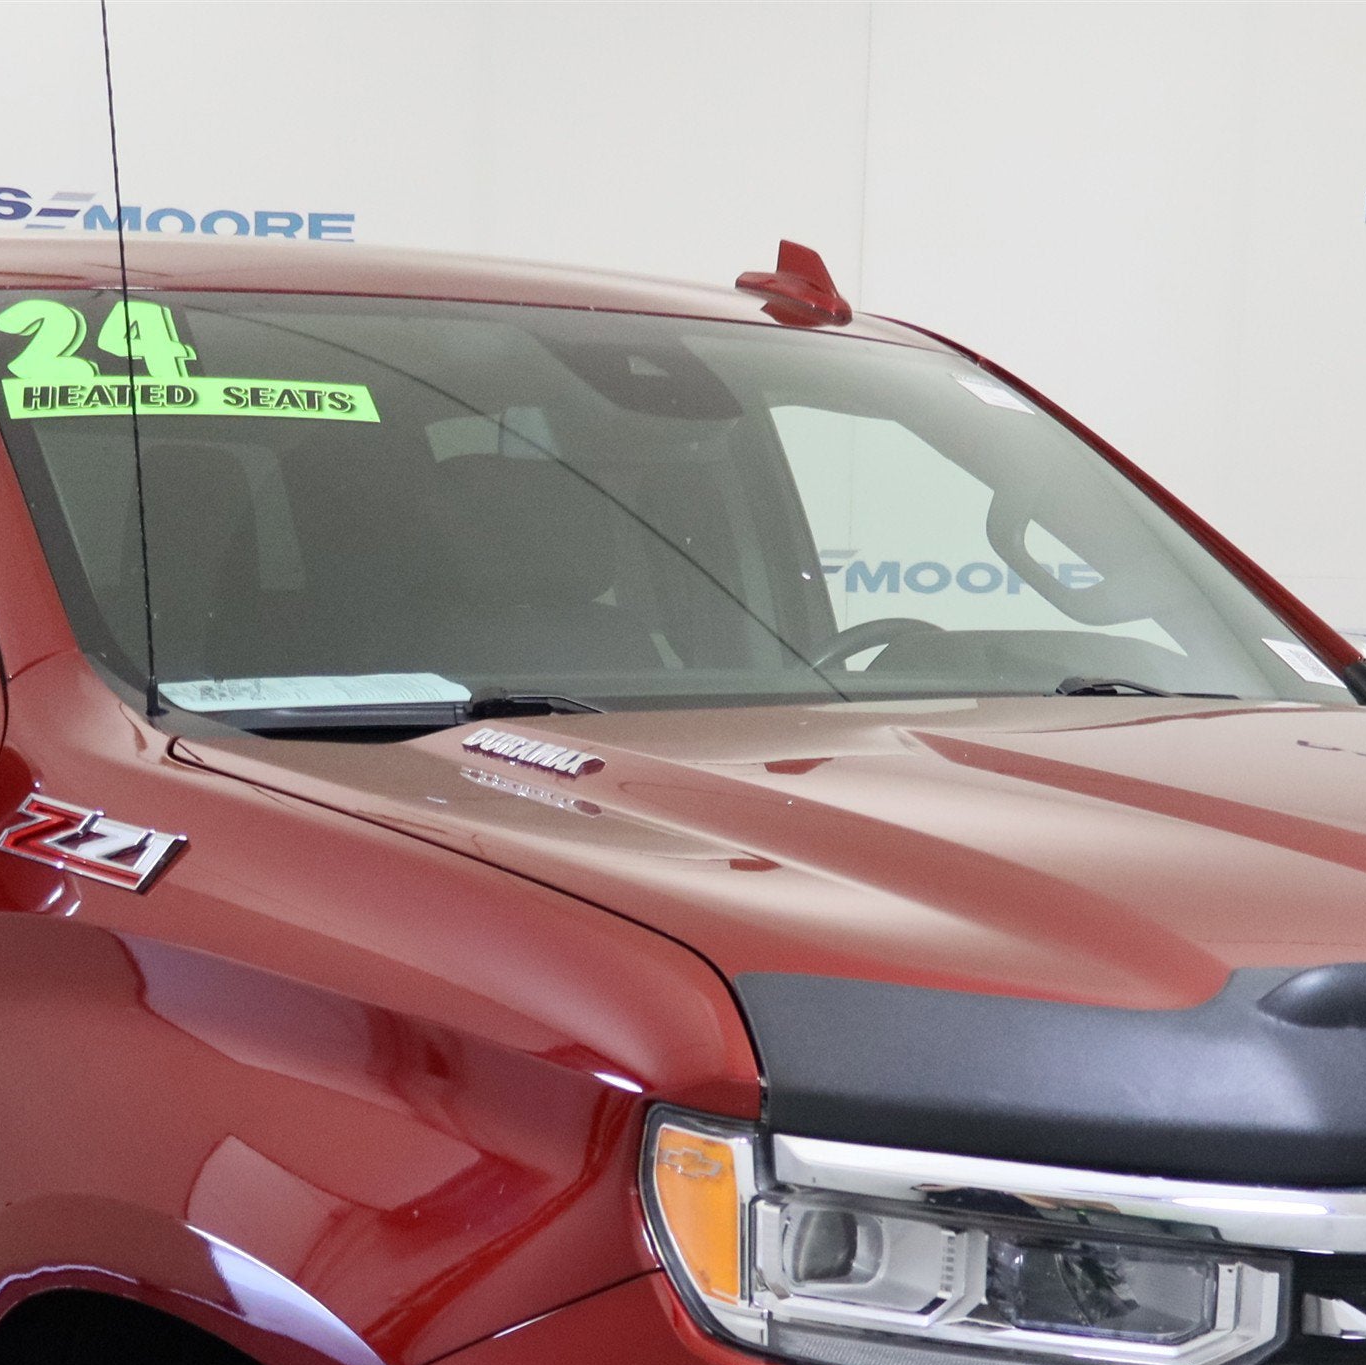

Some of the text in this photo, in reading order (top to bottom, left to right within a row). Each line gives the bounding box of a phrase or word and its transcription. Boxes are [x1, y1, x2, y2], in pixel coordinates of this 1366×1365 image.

[82, 204, 356, 243] MOORE
[22, 383, 358, 414] HEATED SEATS
